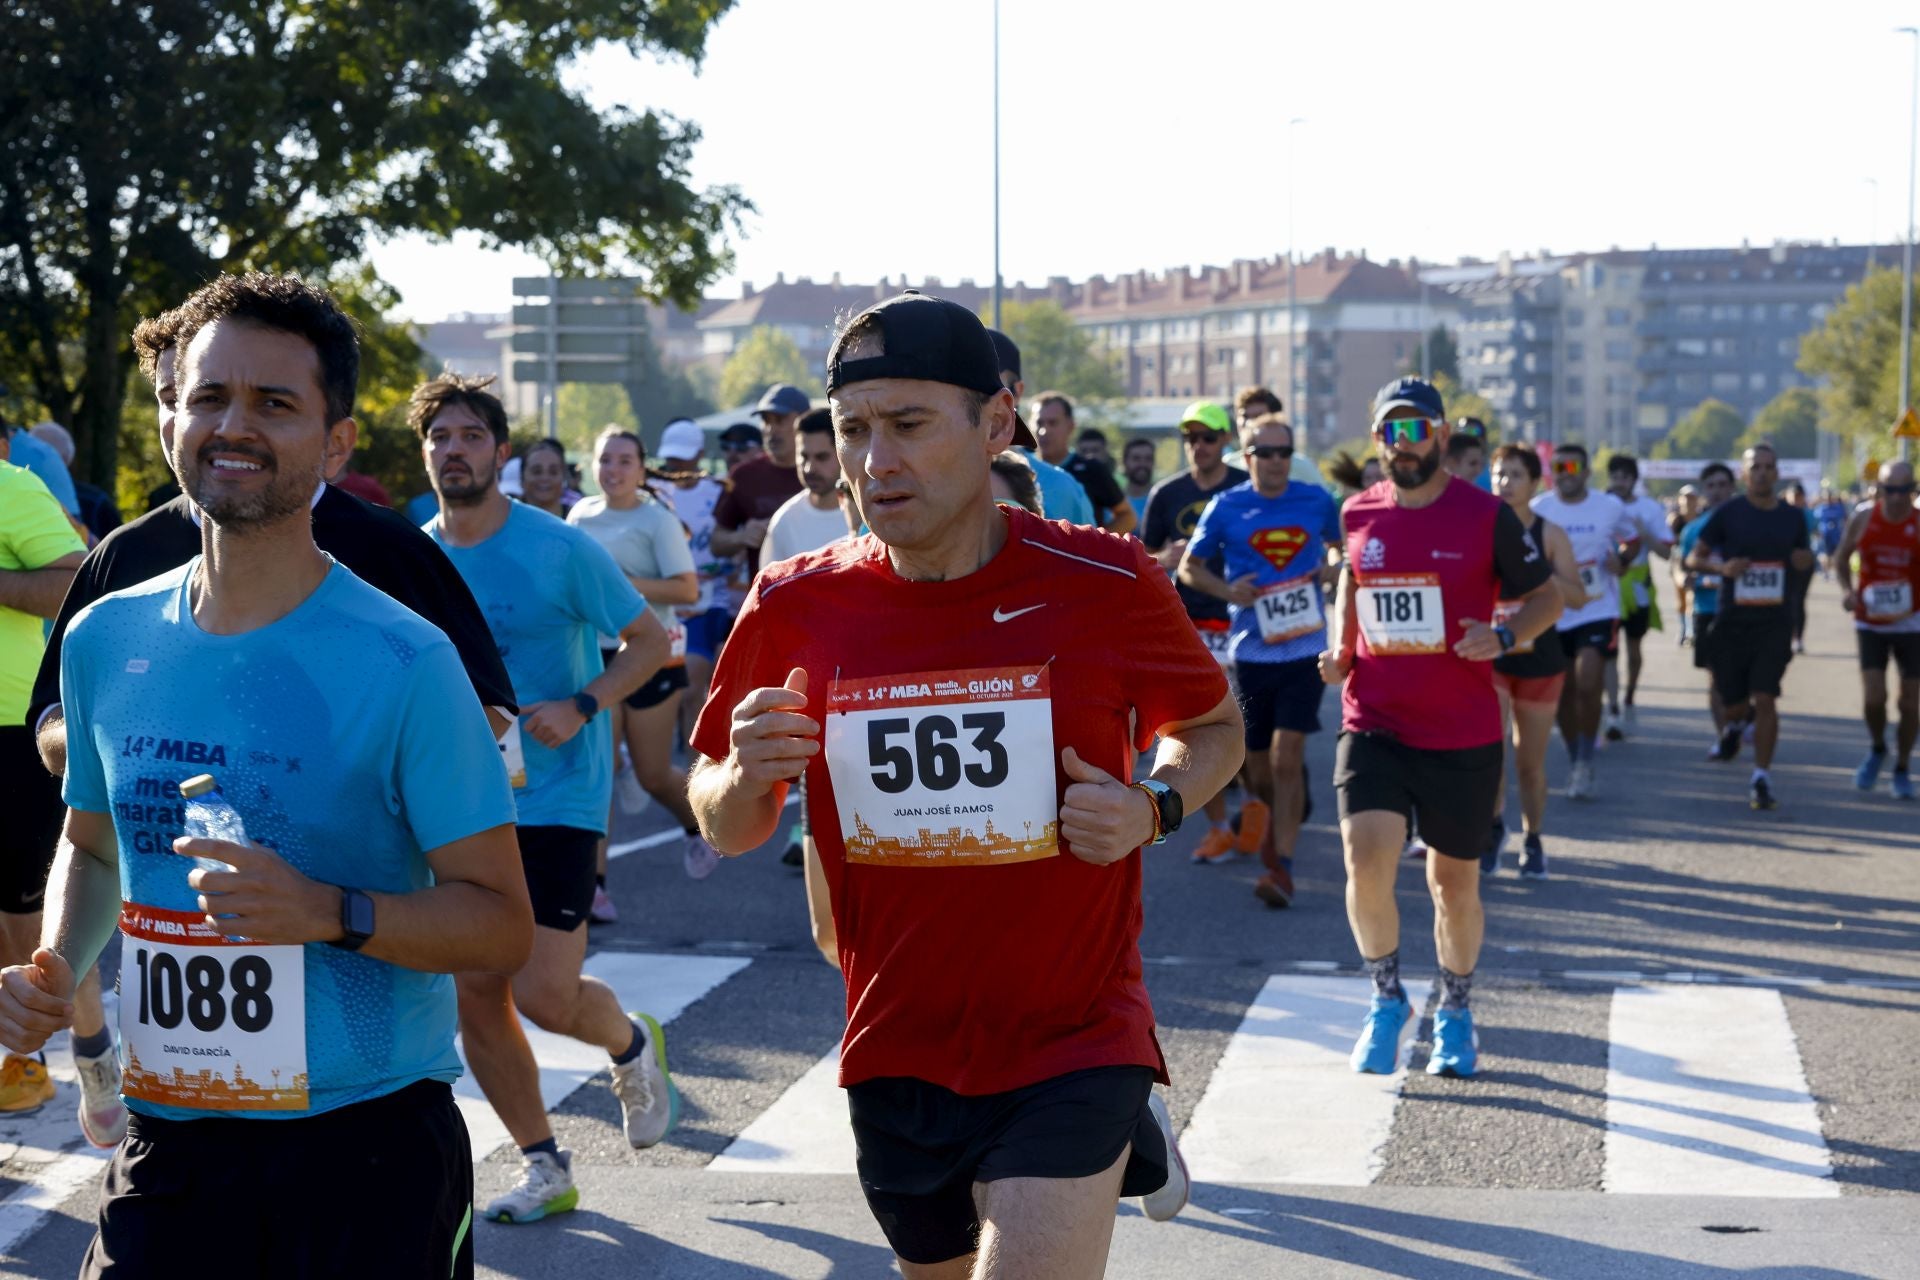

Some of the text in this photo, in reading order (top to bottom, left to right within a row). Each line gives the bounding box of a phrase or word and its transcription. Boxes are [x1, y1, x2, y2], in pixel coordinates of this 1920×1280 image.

[1263, 588, 1309, 620] 1425
[1373, 591, 1424, 623] 1181
[889, 683, 932, 699] MBA
[934, 680, 959, 690] media
[935, 686, 968, 697] maratón
[968, 677, 1014, 694] GIJÓN
[122, 735, 155, 758] 14ª
[155, 738, 227, 767] MBA
[868, 711, 1009, 794] 563
[893, 804, 994, 817] JUAN JOSÉ RAMOS
[154, 920, 187, 936] MBA
[137, 948, 273, 1033] 1088
[163, 1044, 232, 1057] DAVID GARCÍA
